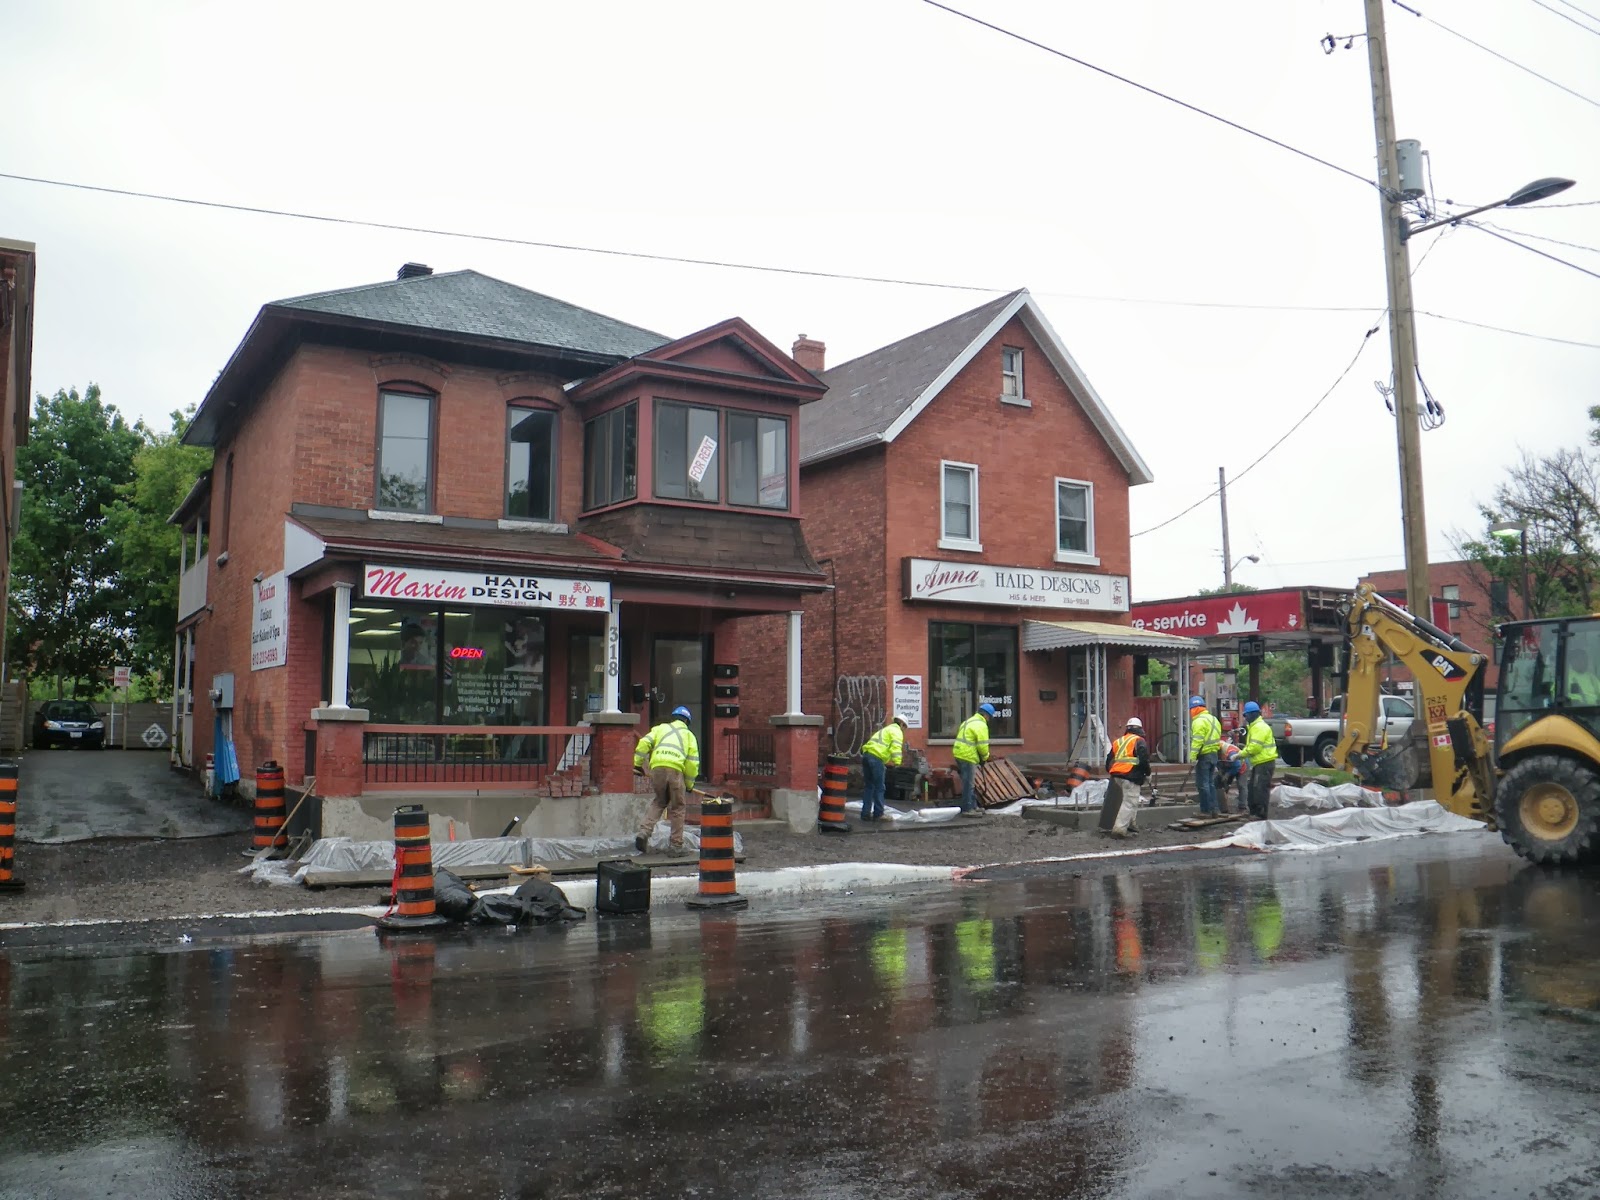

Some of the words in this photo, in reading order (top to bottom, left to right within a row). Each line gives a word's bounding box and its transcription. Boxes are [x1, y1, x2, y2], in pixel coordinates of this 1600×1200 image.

[691, 460, 704, 480] FOR
[698, 438, 715, 462] RENT
[367, 568, 467, 600] Maxim
[485, 575, 539, 590] HAIR
[916, 562, 980, 592] Anna
[995, 571, 1034, 590] HAIR
[1040, 575, 1101, 594] DESIGNS
[472, 586, 552, 601] DESIGN
[1009, 593, 1020, 601] HIS
[451, 647, 484, 658] OPEN
[608, 627, 619, 677] 318
[1432, 655, 1454, 677] CAT
[979, 695, 1003, 704] Manicure
[1003, 695, 1013, 704] $15
[896, 704, 920, 712] Parking
[1002, 709, 1012, 718] $30
